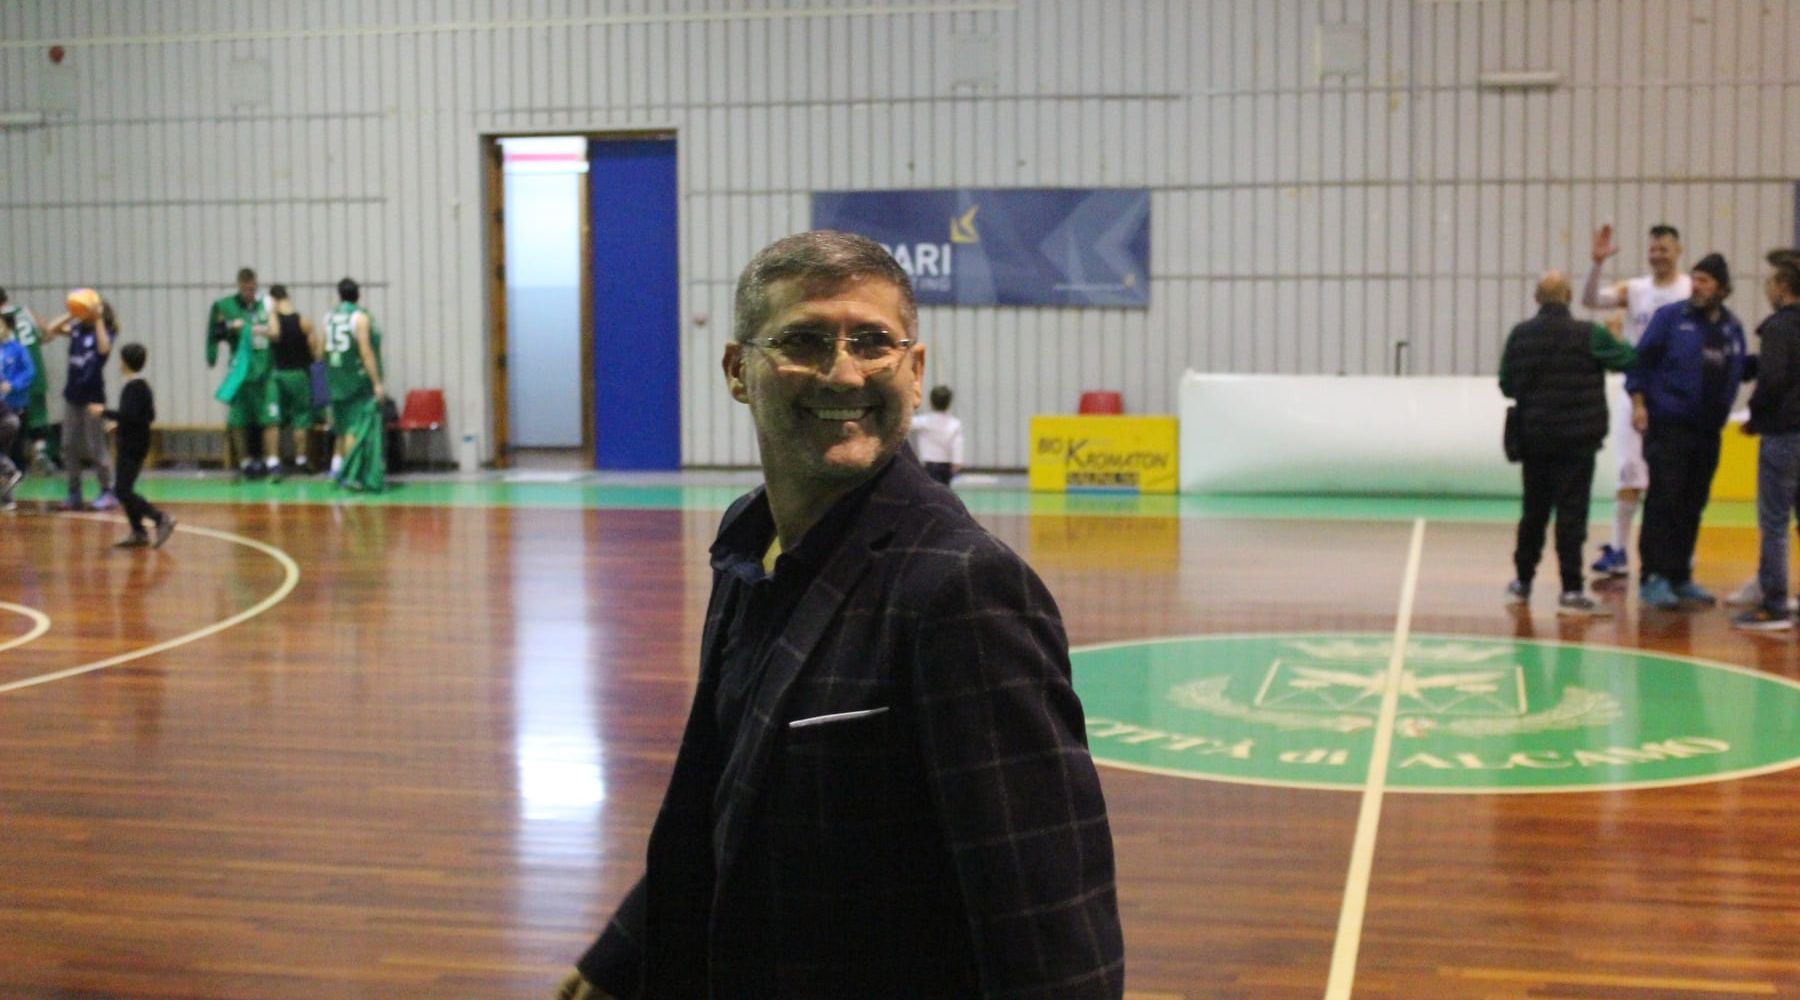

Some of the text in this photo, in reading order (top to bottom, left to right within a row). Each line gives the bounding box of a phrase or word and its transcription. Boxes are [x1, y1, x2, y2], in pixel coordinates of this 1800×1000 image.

[879, 242, 952, 276] ARI
[324, 323, 351, 353] 15
[1397, 737, 1731, 770] ALCAMO
